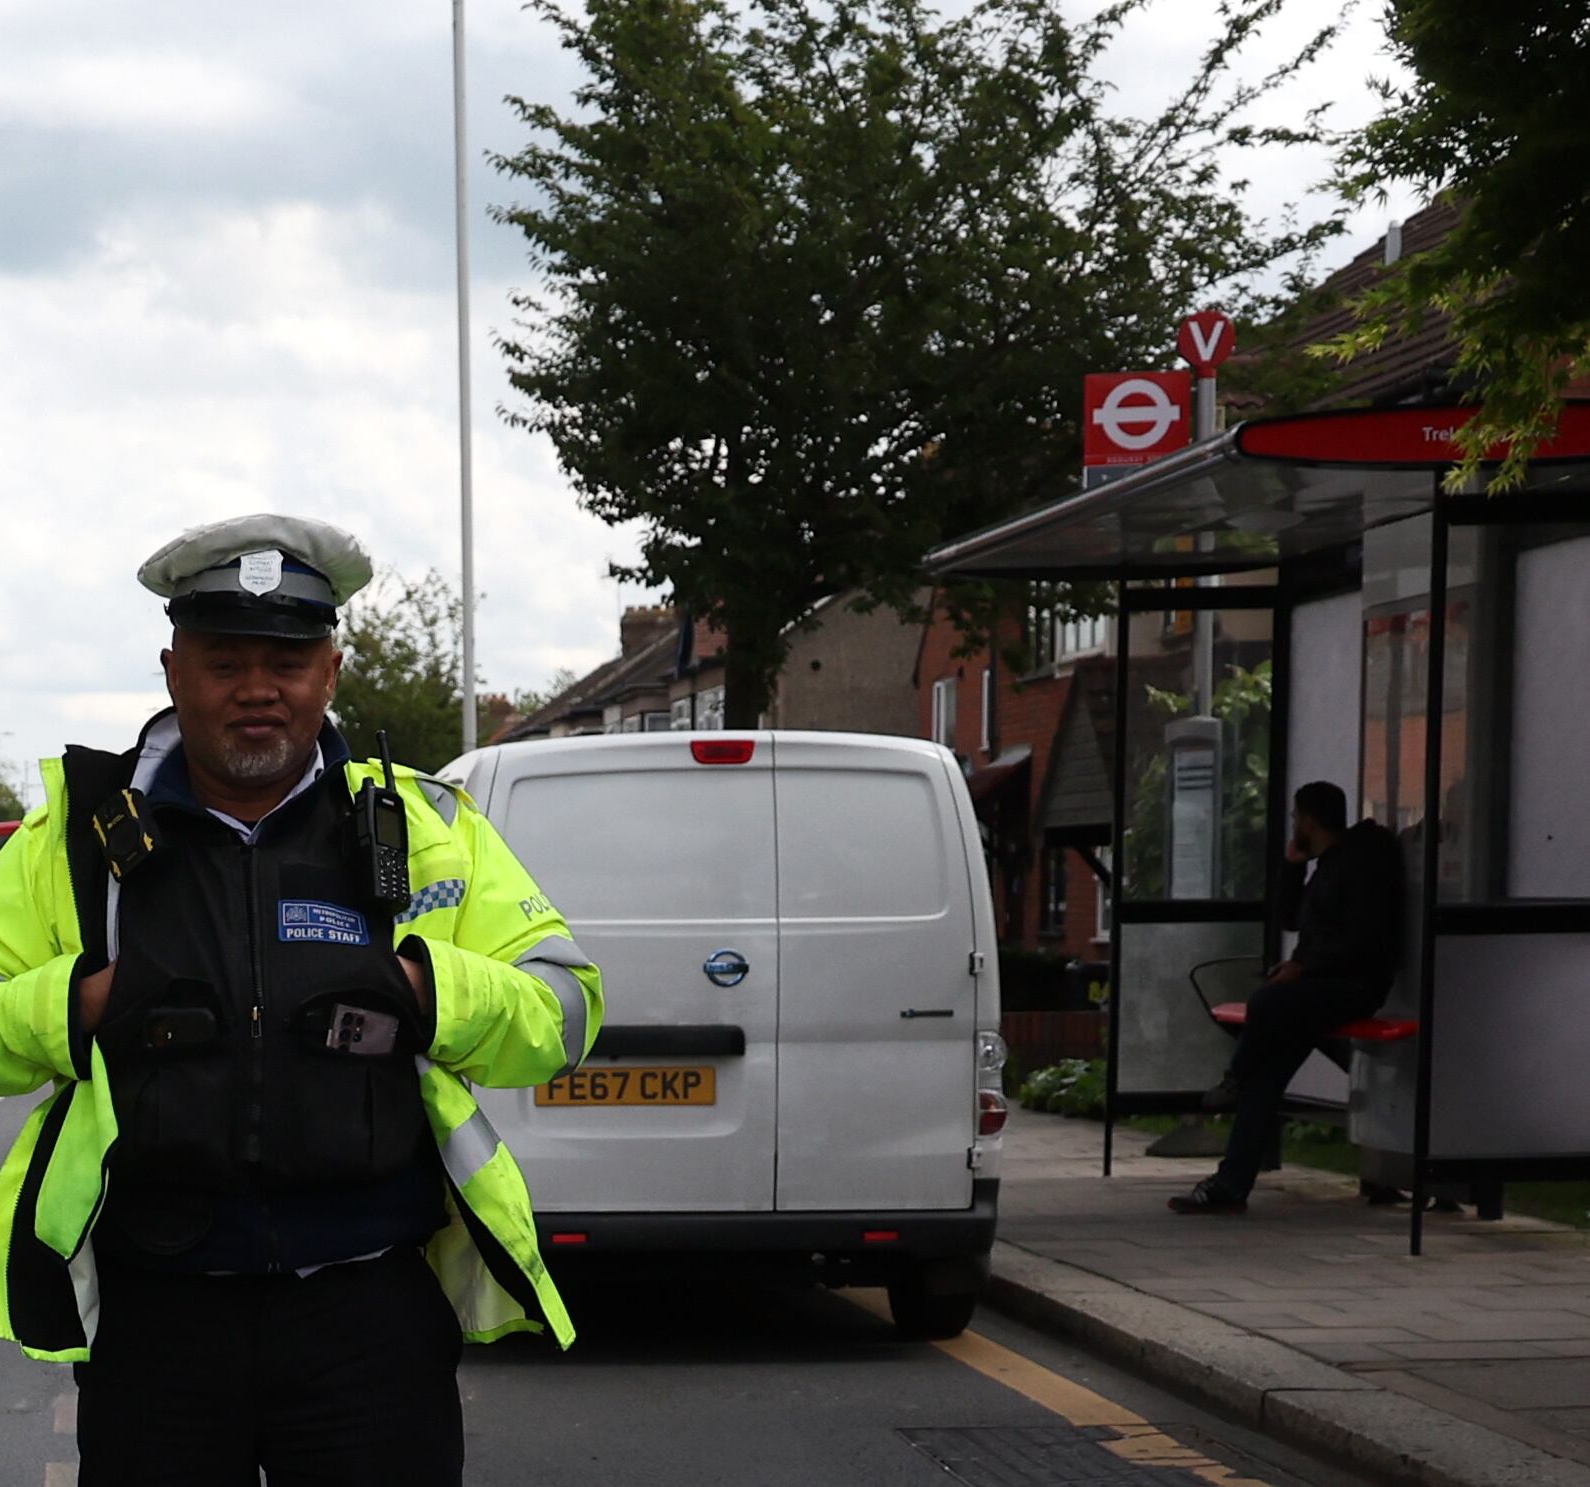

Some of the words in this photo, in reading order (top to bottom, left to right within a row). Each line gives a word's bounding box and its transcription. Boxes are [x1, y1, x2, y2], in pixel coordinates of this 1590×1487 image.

[1188, 320, 1225, 362] V
[286, 928, 324, 939] POLICE
[328, 929, 361, 943] STAFF
[547, 1072, 630, 1101] FE67
[639, 1072, 702, 1101] CKP
